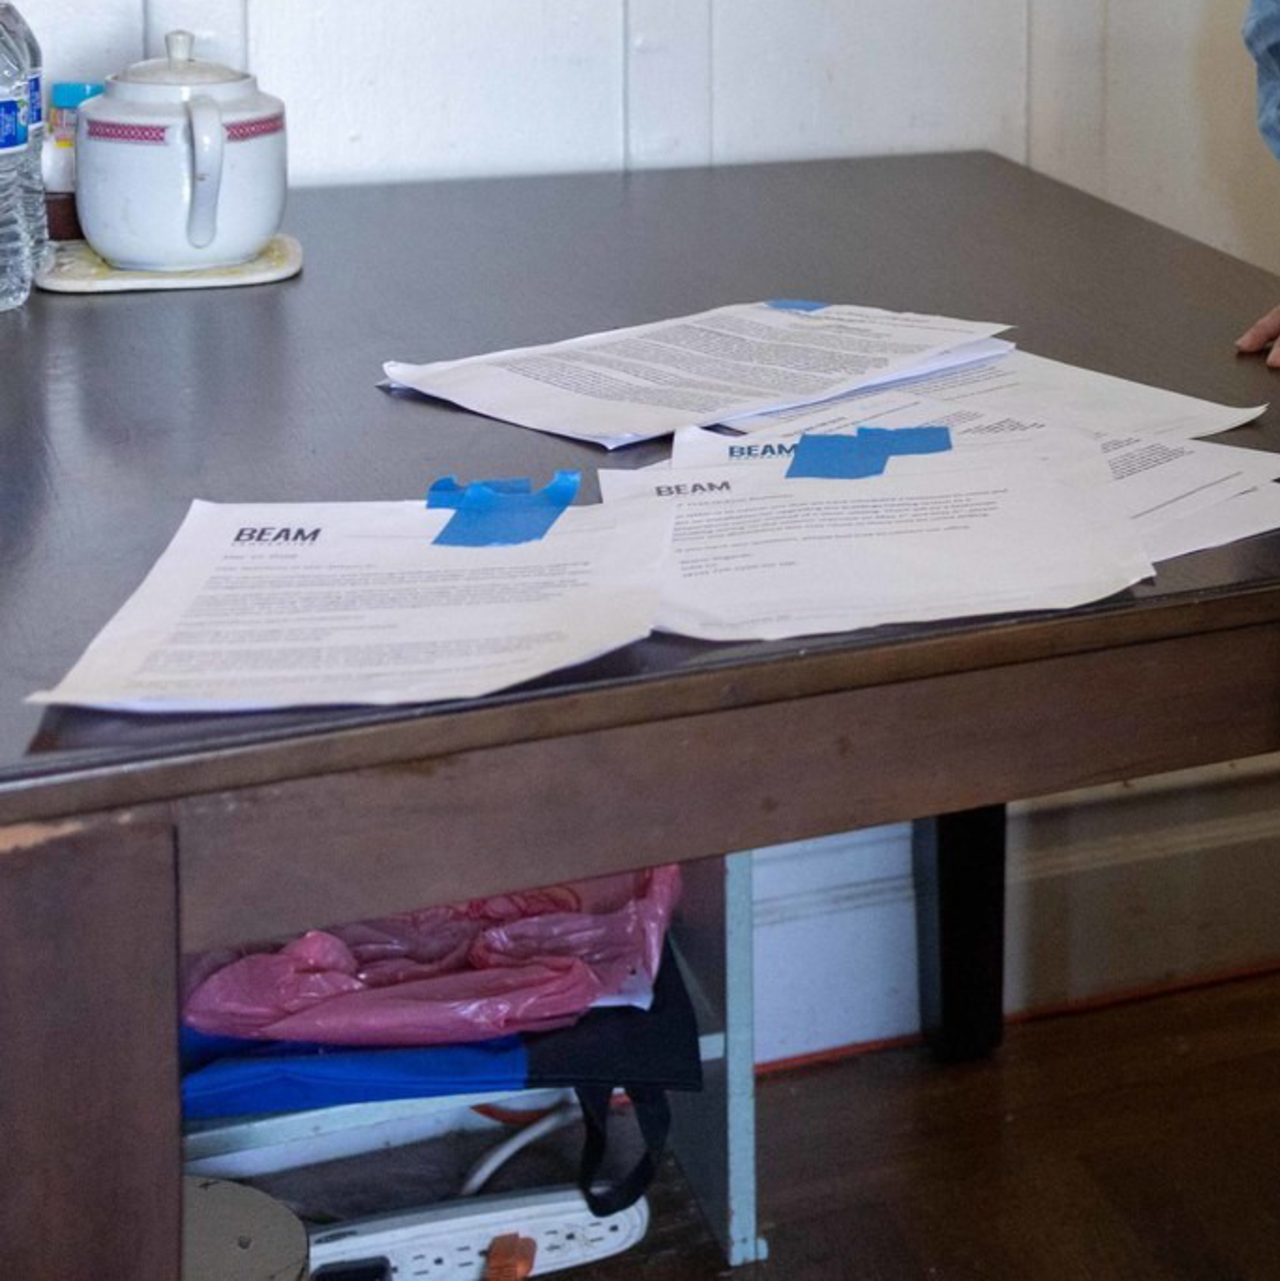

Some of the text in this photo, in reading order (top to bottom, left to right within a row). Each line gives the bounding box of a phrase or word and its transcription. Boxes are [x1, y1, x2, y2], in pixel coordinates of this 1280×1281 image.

[728, 443, 797, 458] BEAM
[655, 481, 731, 496] BEAM
[234, 527, 321, 542] BEAM
